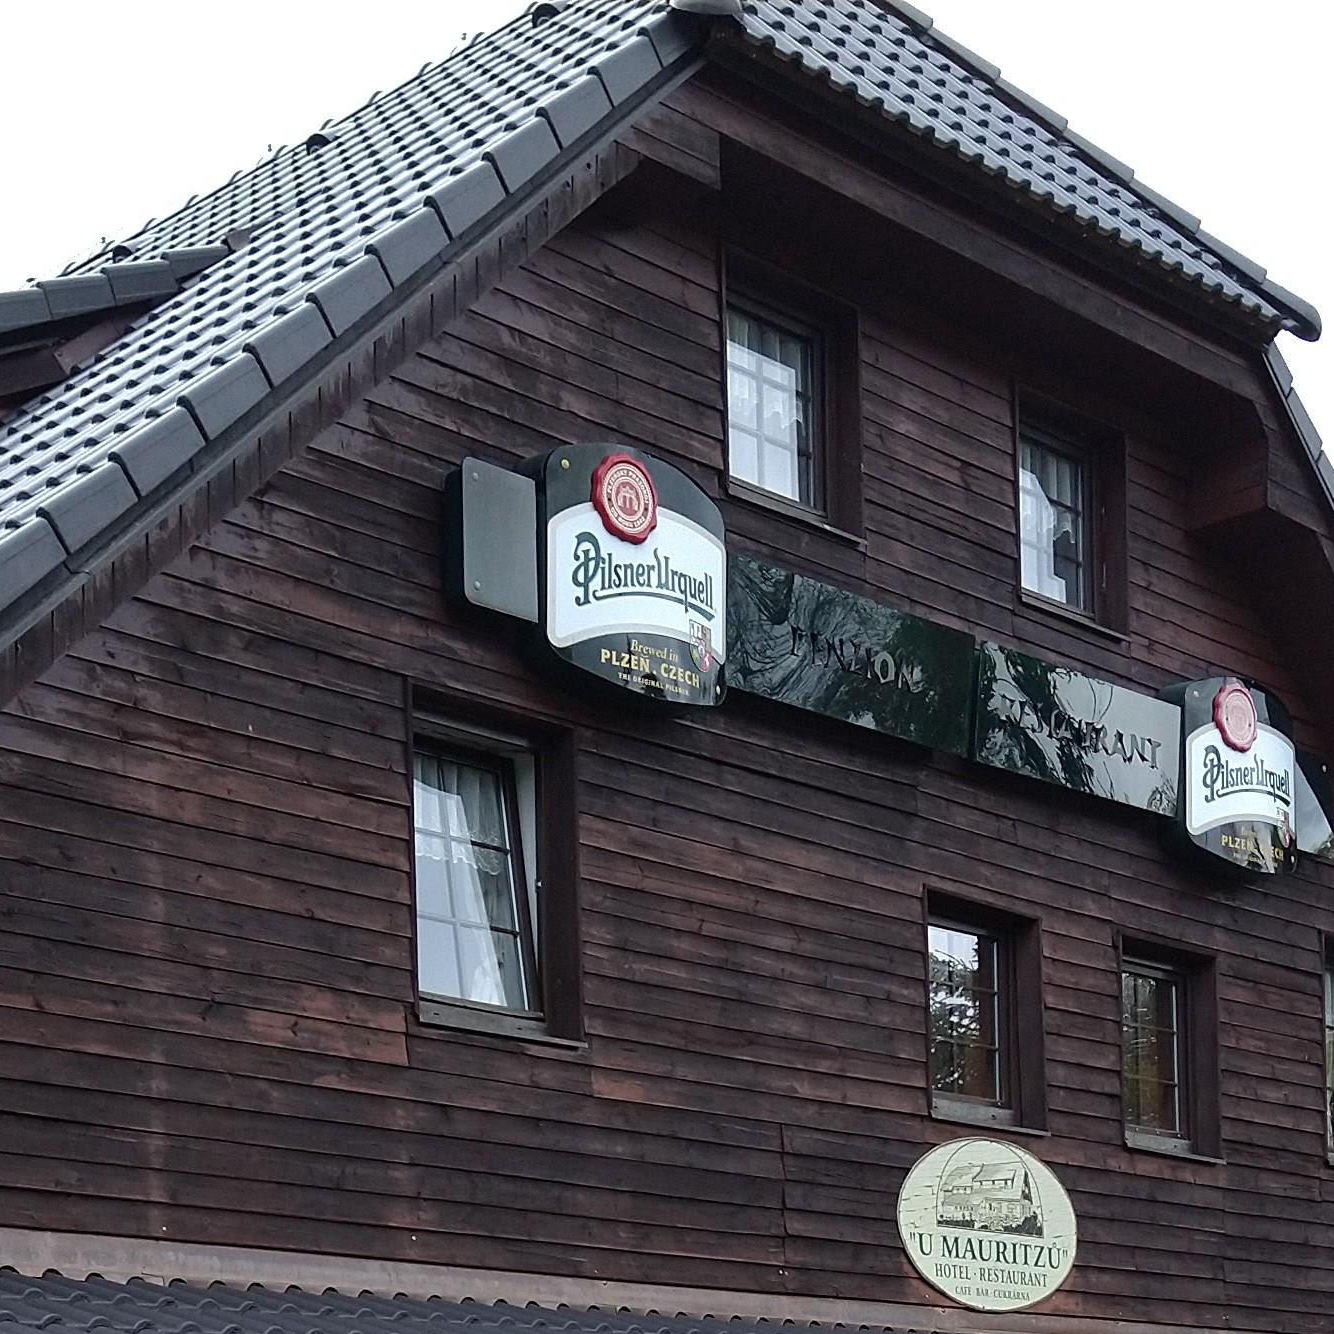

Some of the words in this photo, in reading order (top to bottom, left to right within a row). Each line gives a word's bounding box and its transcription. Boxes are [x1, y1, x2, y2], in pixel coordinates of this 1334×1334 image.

[571, 531, 657, 606] Pilsner
[653, 547, 714, 612] Urquell
[630, 639, 667, 658] Brewed
[669, 648, 679, 662] in
[600, 648, 651, 673] PLZEN
[660, 663, 700, 688] CZECH
[618, 672, 631, 681] THE
[1203, 744, 1256, 803] Pilsner
[1254, 753, 1291, 802] Urquell
[935, 1263, 971, 1280] HOTEL
[979, 1267, 1048, 1287] RESTAURANT
